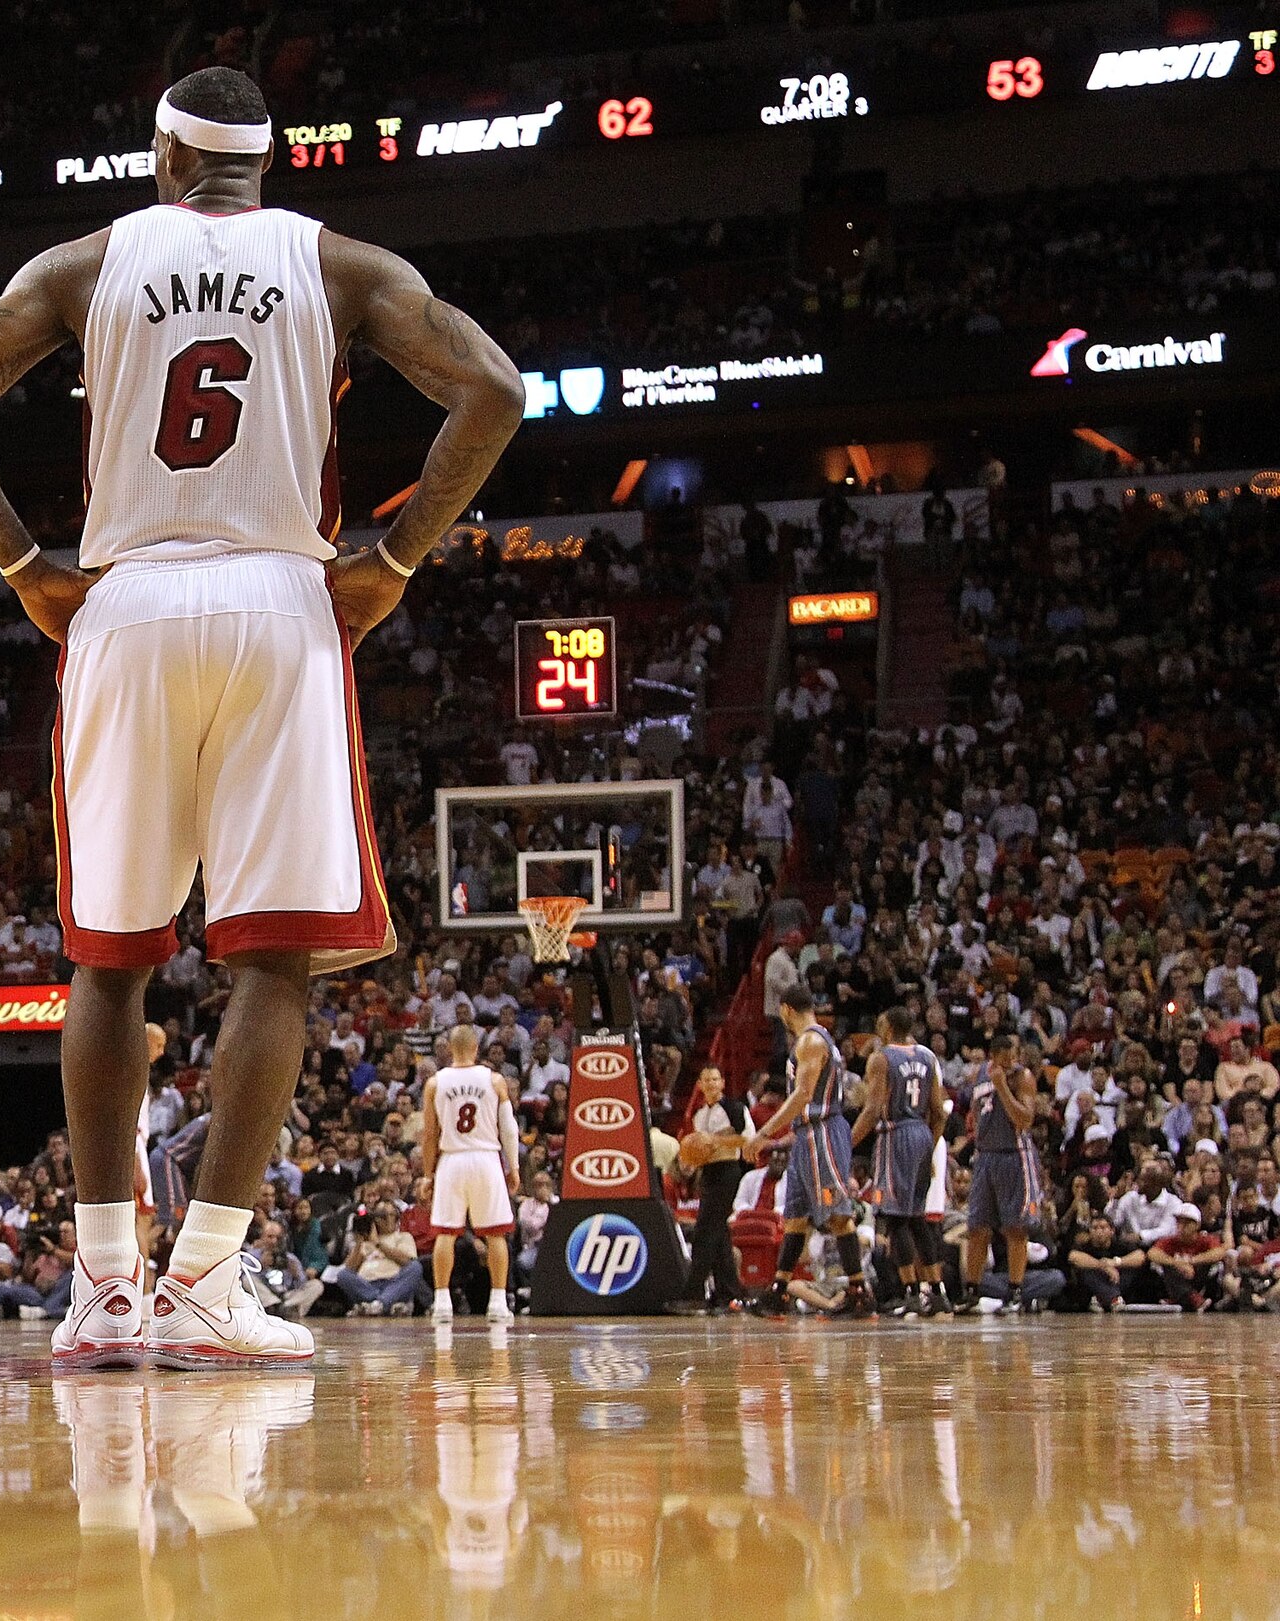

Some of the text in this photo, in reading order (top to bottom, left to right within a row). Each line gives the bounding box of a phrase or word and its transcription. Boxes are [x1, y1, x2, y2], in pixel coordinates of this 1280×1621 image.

[1249, 30, 1278, 50] TF
[1255, 50, 1275, 75] 3
[780, 73, 850, 106] 7:08
[987, 57, 1044, 100] 53
[376, 118, 402, 136] TF
[598, 97, 653, 139] 62
[761, 98, 848, 125] QUARTER
[417, 101, 563, 156] HEAT
[379, 137, 399, 161] 3
[143, 273, 284, 324] JAMES
[1085, 333, 1226, 372] Carnival
[152, 334, 254, 474] 6
[792, 597, 871, 619] BACARDI
[545, 628, 605, 659] 7:08
[536, 660, 598, 711] 24
[586, 1057, 621, 1073] KIA
[456, 1103, 477, 1134] 8
[585, 1105, 624, 1123] KIA
[583, 1160, 628, 1178] KIA
[577, 1214, 641, 1296] hp
